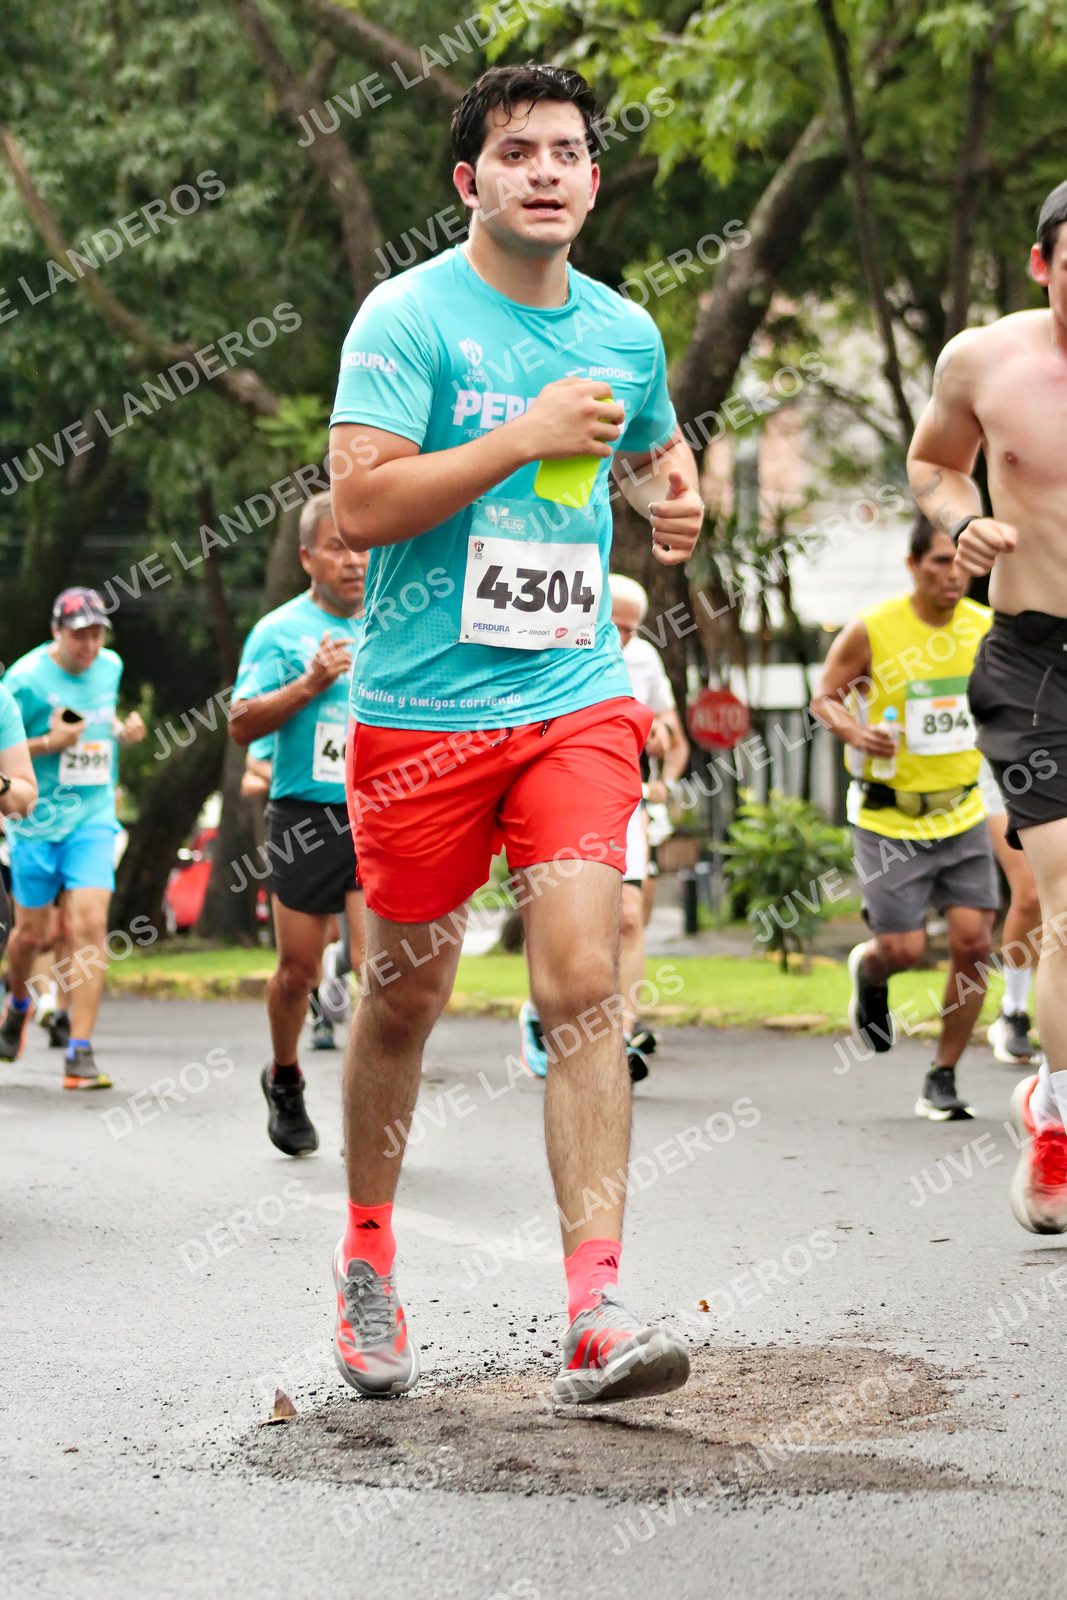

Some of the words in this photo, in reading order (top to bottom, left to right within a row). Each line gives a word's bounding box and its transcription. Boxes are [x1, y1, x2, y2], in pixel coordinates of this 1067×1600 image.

[588, 366, 634, 380] BROOKS
[476, 565, 595, 613] 4304
[472, 622, 511, 633] PERDURA
[575, 638, 592, 646] 4304
[357, 684, 395, 704] familia
[398, 696, 405, 708] y
[410, 698, 456, 711] amigos
[459, 693, 521, 709] corriendo
[691, 705, 745, 731] ALTO
